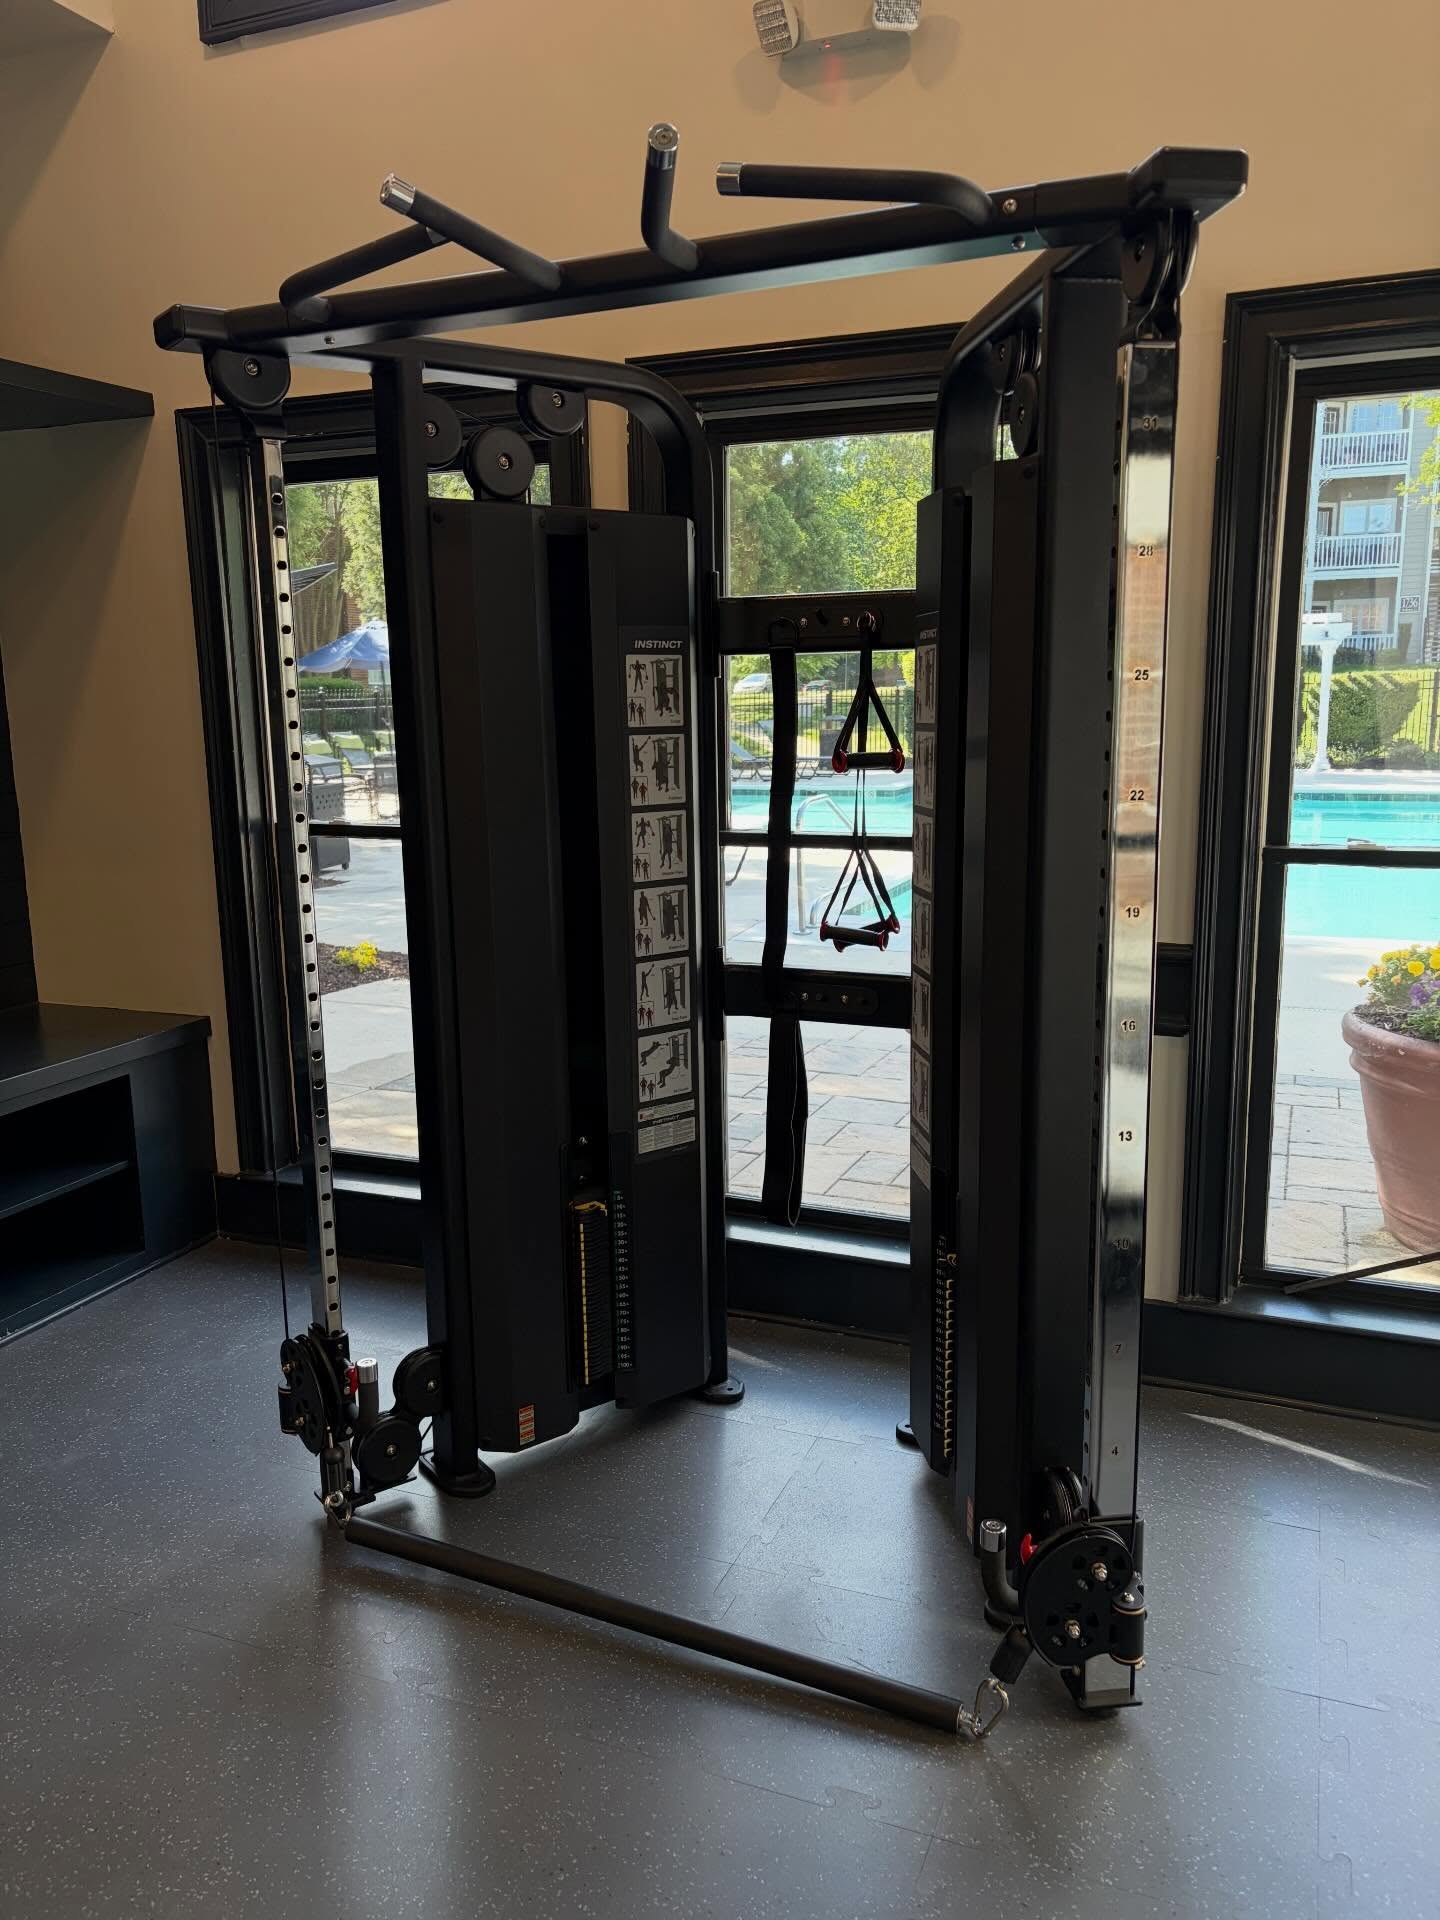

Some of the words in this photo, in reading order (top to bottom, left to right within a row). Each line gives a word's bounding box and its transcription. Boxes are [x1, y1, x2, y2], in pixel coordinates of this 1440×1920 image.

[1143, 417, 1158, 429] 31
[1138, 545, 1154, 557] 28
[634, 639, 683, 649] INSTINCT
[1134, 669, 1149, 681] 25
[1129, 790, 1144, 801] 22
[1125, 907, 1140, 918] 19
[1121, 1020, 1136, 1031] 16
[1118, 1131, 1133, 1142] 13
[1113, 1344, 1121, 1354] 7
[1111, 1446, 1118, 1456] 4
